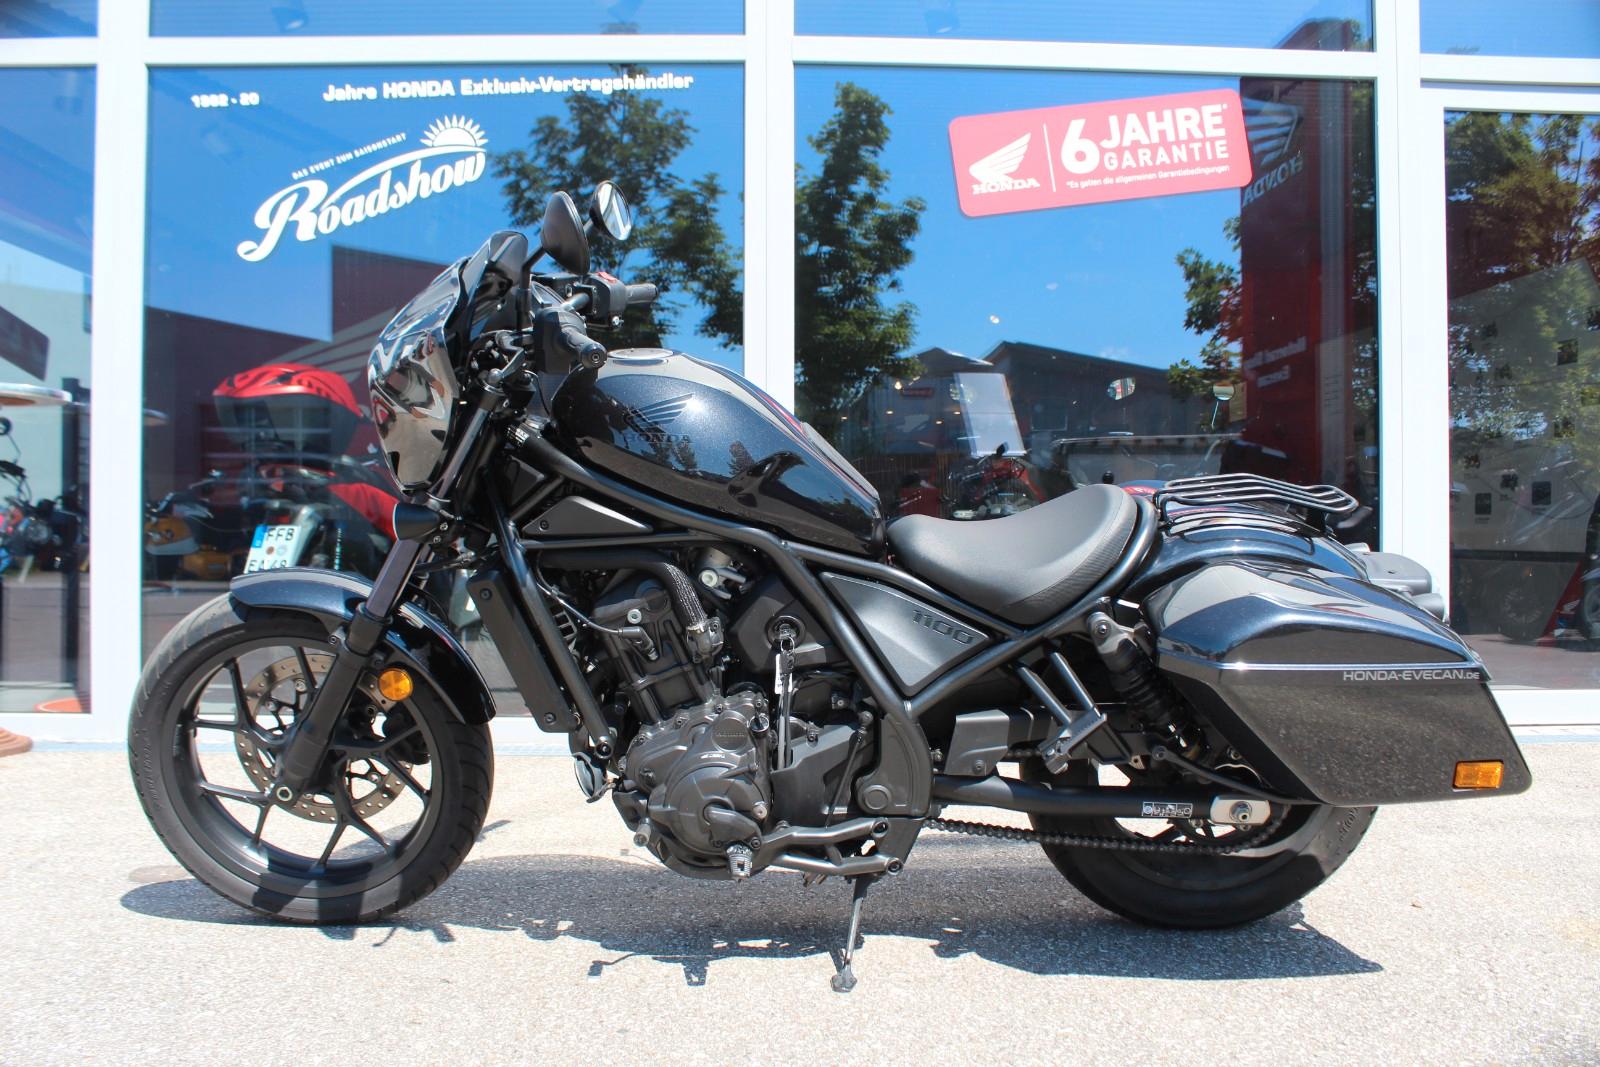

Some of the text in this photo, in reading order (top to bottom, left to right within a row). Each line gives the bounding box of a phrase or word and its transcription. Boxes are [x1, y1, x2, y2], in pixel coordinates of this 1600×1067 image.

[322, 83, 378, 102] Jahre
[382, 79, 456, 98] HONDA
[1061, 118, 1100, 175] 6
[1103, 139, 1229, 171] GARANTIE
[971, 177, 1041, 195] HONDA
[236, 151, 487, 262] Roadshow
[912, 609, 974, 645] 1100
[1343, 669, 1481, 681] HONDA-EVECAN.DE
